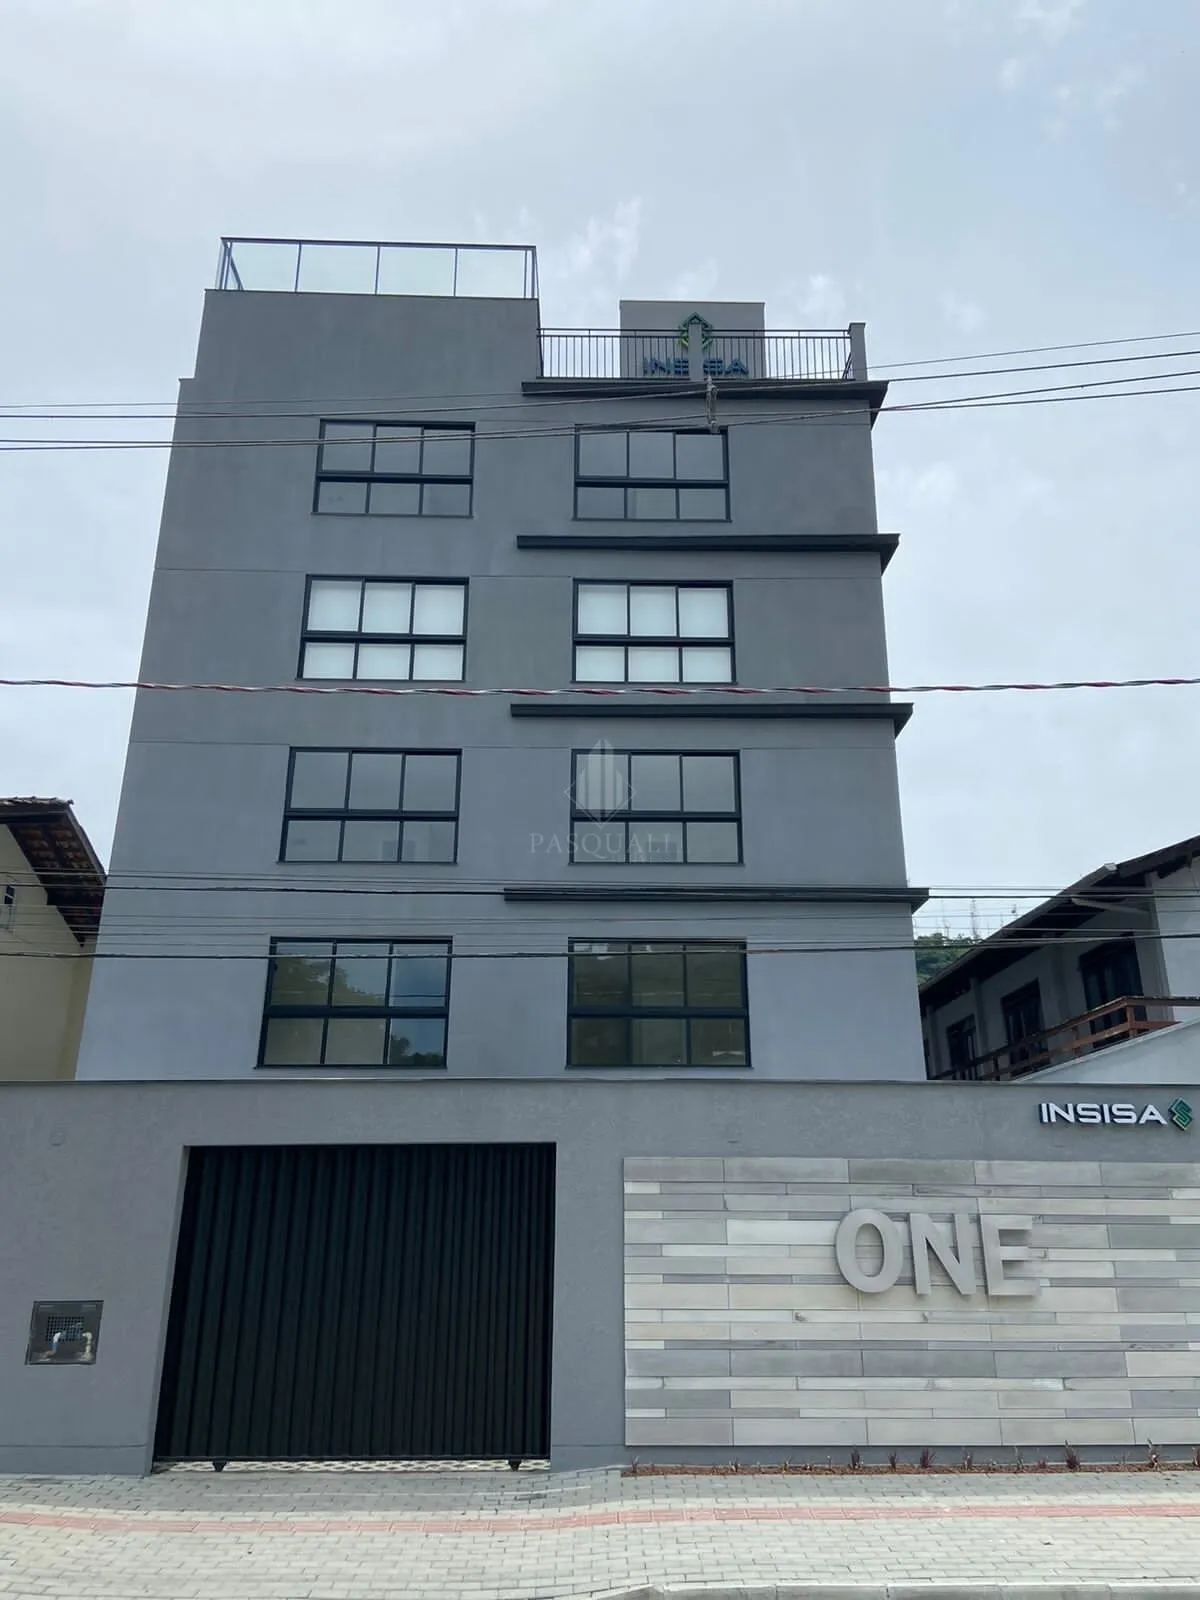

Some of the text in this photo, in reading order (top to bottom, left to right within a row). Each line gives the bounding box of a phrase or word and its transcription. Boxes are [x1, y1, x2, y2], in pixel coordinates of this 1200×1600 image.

[643, 358, 749, 375] INSSA
[1039, 1103, 1168, 1125] INSISA
[836, 1208, 1041, 1296] ONE
